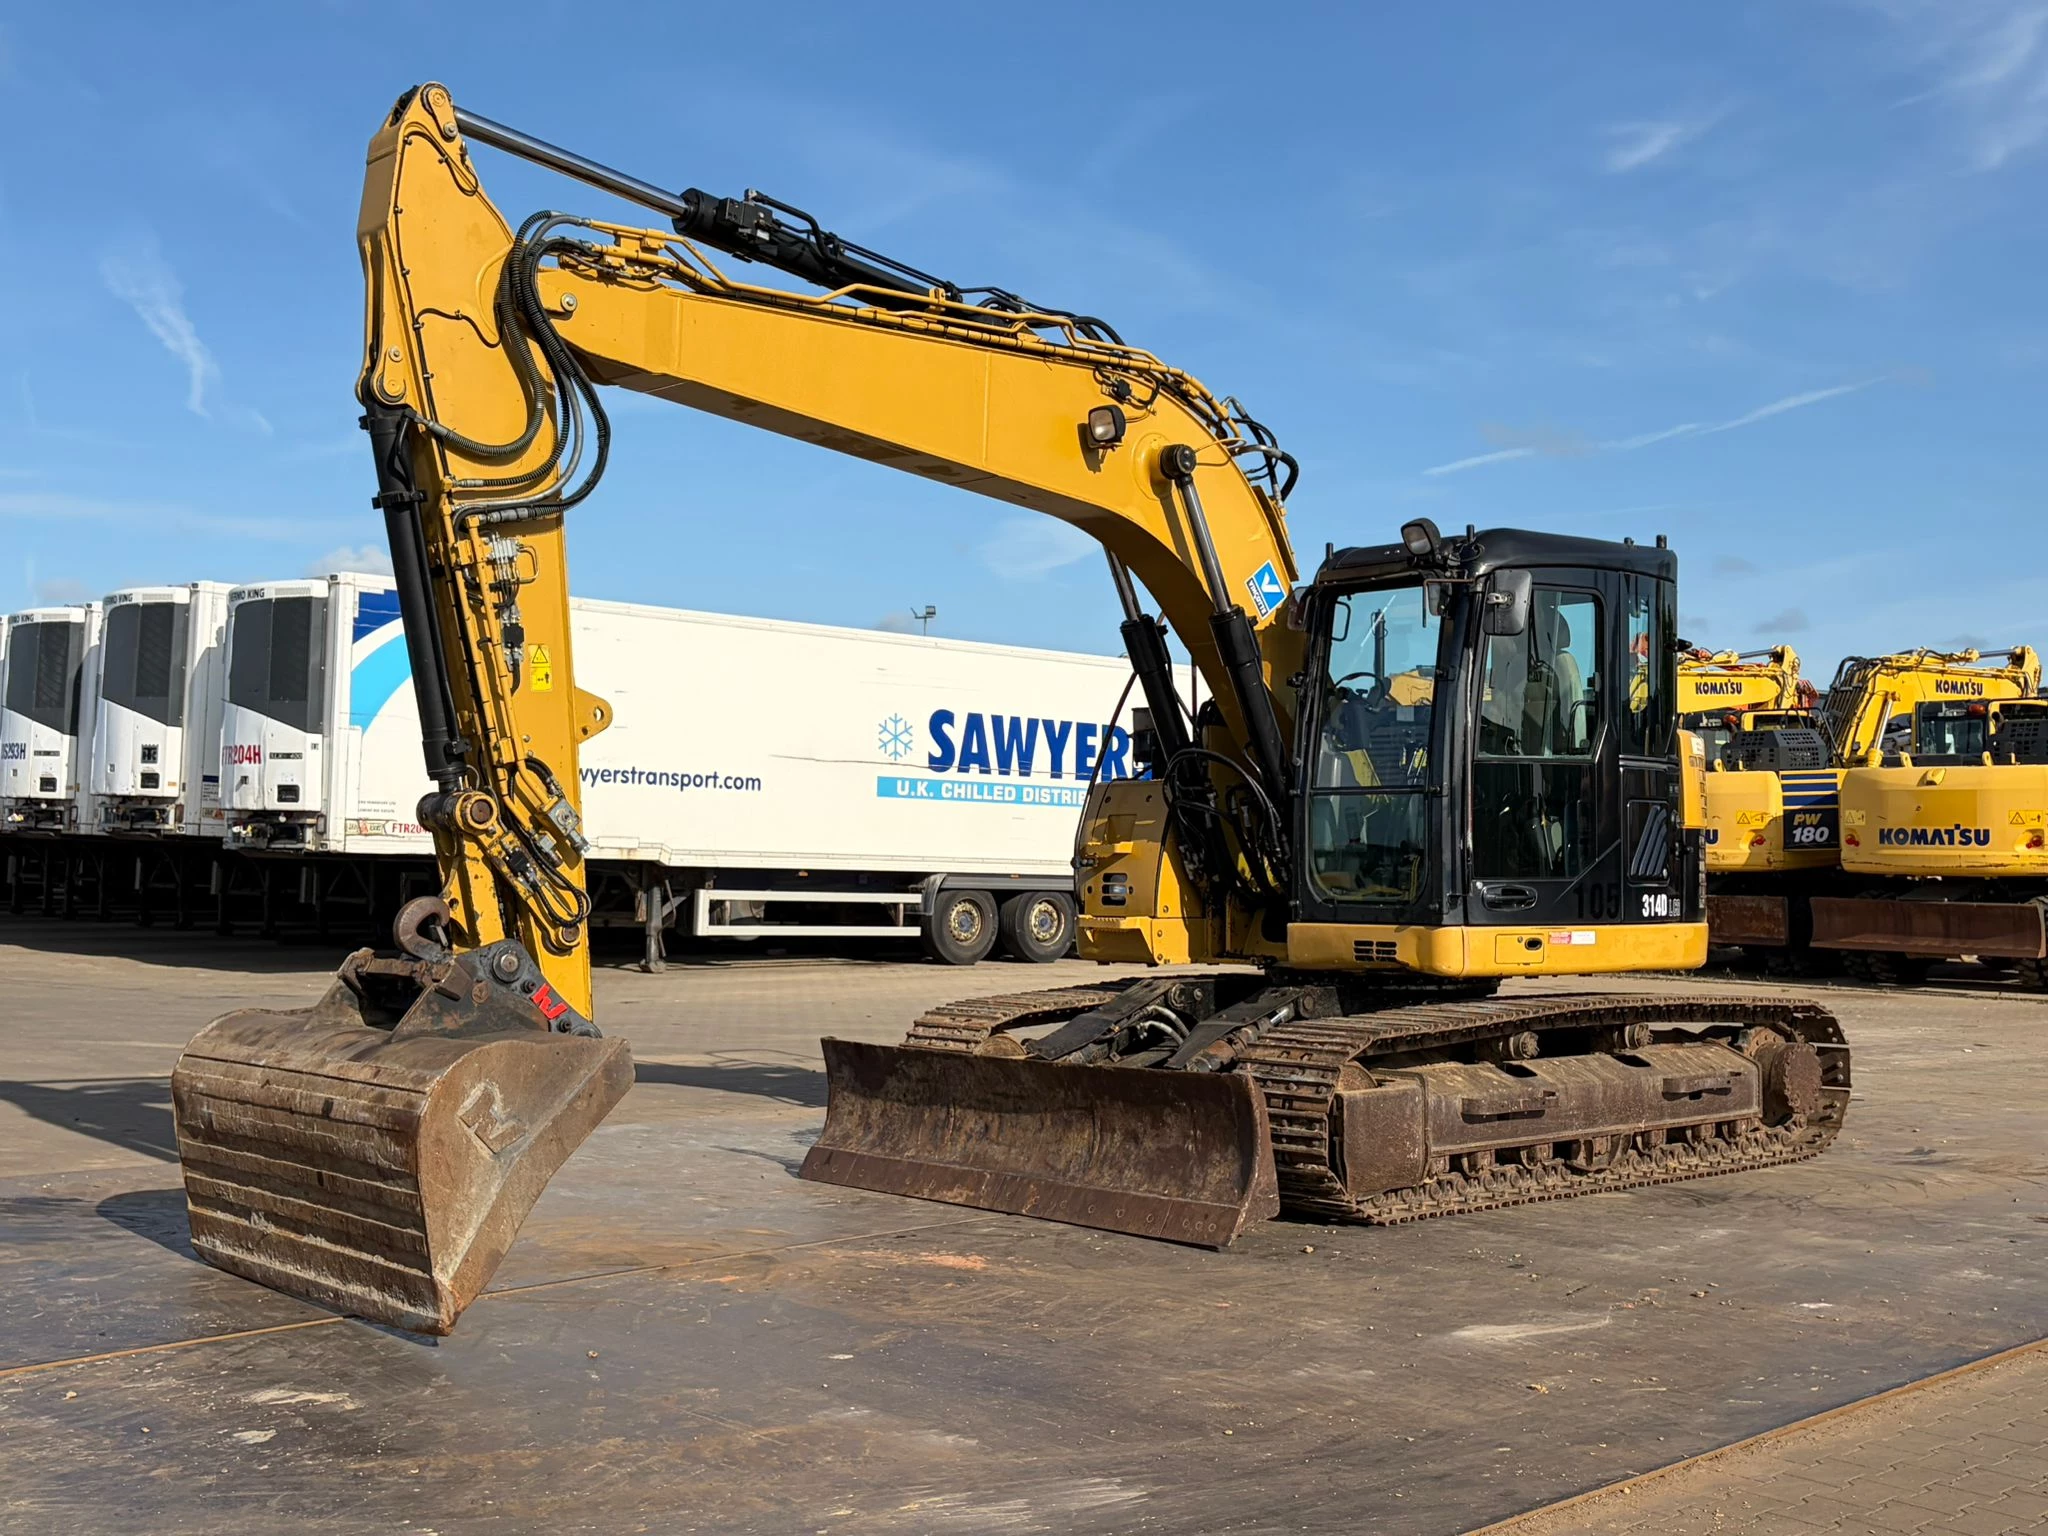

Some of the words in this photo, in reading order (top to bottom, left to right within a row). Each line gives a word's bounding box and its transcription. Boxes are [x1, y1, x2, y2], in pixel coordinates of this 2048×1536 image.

[247, 588, 265, 599] KING
[1695, 678, 1742, 694] KOMATSU
[1935, 678, 1983, 696] KOMATSU
[928, 709, 1152, 781] SAWYER
[579, 766, 762, 792] wyerstransport.com
[896, 779, 934, 798] U.K.
[941, 783, 1017, 803] CHILLED
[1793, 813, 1822, 826] PW
[392, 823, 432, 836] FTR20
[1792, 826, 1830, 843] 180
[1879, 823, 1991, 846] KOMATSU
[1641, 894, 1667, 918] 314D
